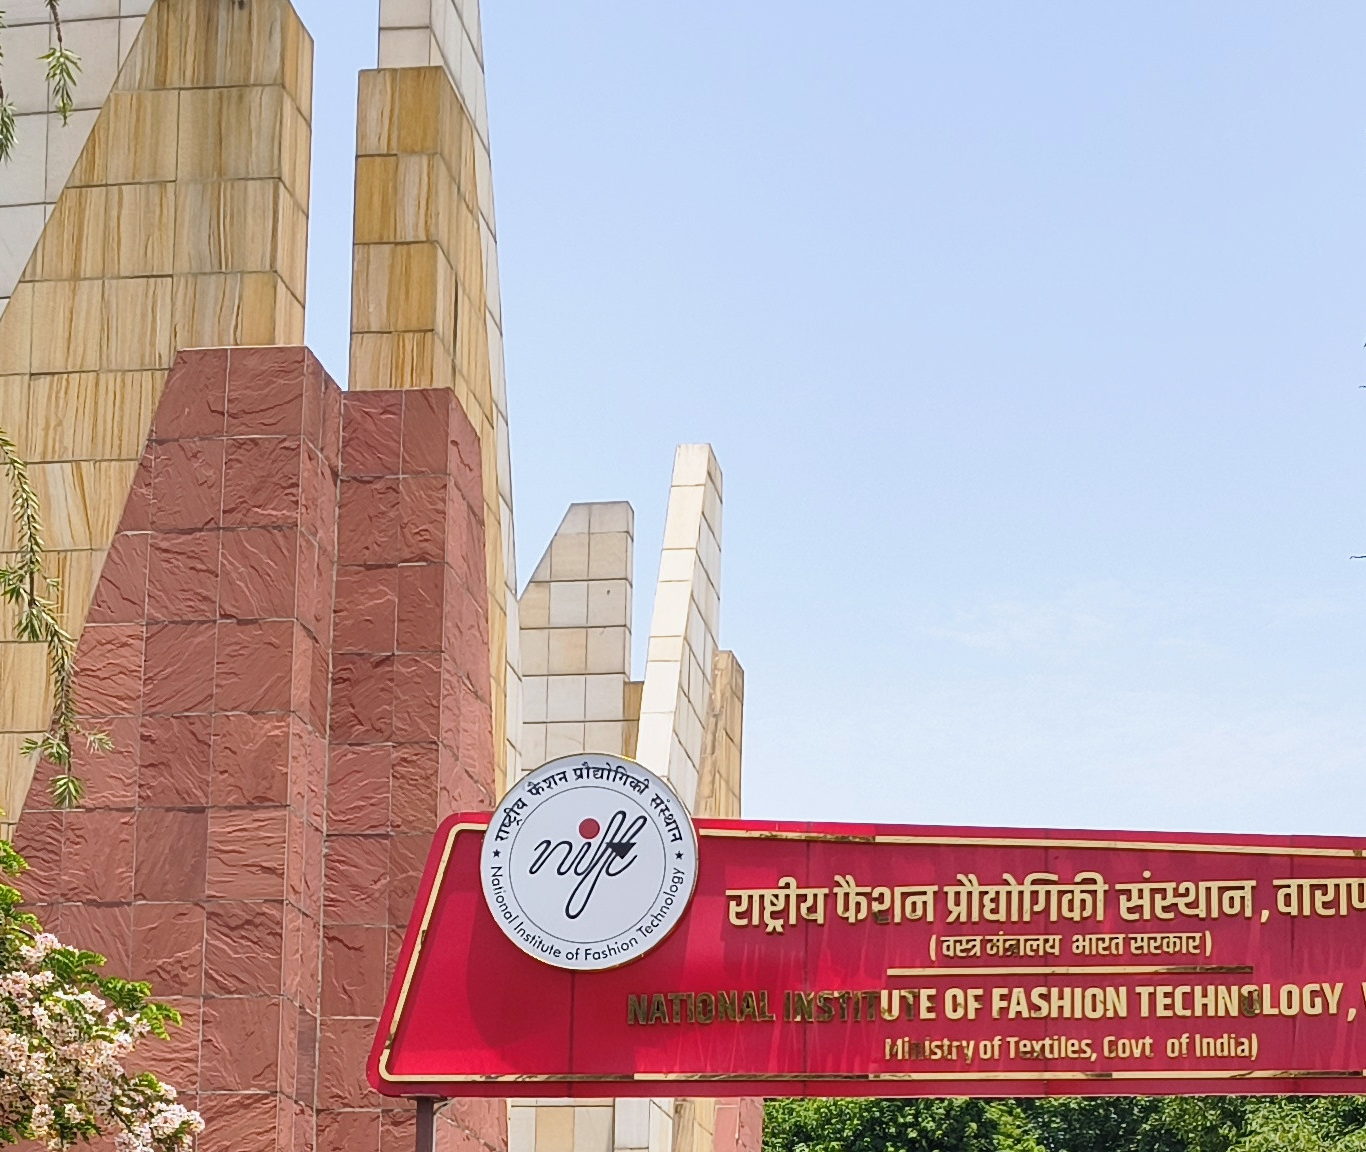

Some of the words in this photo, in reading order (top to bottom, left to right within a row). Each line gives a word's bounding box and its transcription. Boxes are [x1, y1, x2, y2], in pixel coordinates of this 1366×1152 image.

[495, 797, 528, 842] राष्ट्रीय
[527, 768, 569, 797] फैशन
[573, 762, 650, 796] प्रौद्योगिकी
[649, 793, 683, 844] संस्थान
[490, 865, 519, 925] National
[513, 921, 562, 958] Institute
[565, 947, 580, 961] of
[584, 935, 639, 961] Fashion
[635, 867, 686, 939] Technology
[725, 876, 829, 933] राष्ट्रीय
[833, 874, 938, 924] फैशन
[943, 872, 1108, 923] प्रौद्योगिकी
[985, 931, 1062, 958] मंत्रालय
[1071, 933, 1126, 956] भारत
[1128, 930, 1212, 957] सरकार)
[627, 990, 776, 1025] NATIONAL
[784, 987, 937, 1022] INSTITUTE
[943, 987, 983, 1021] OF
[991, 986, 1128, 1020] FASHION
[885, 1036, 975, 1064] Ministry
[979, 1035, 1002, 1060] of
[1006, 1035, 1097, 1062] Textiles,
[1166, 1034, 1189, 1060] of
[1194, 1033, 1258, 1061] India)
